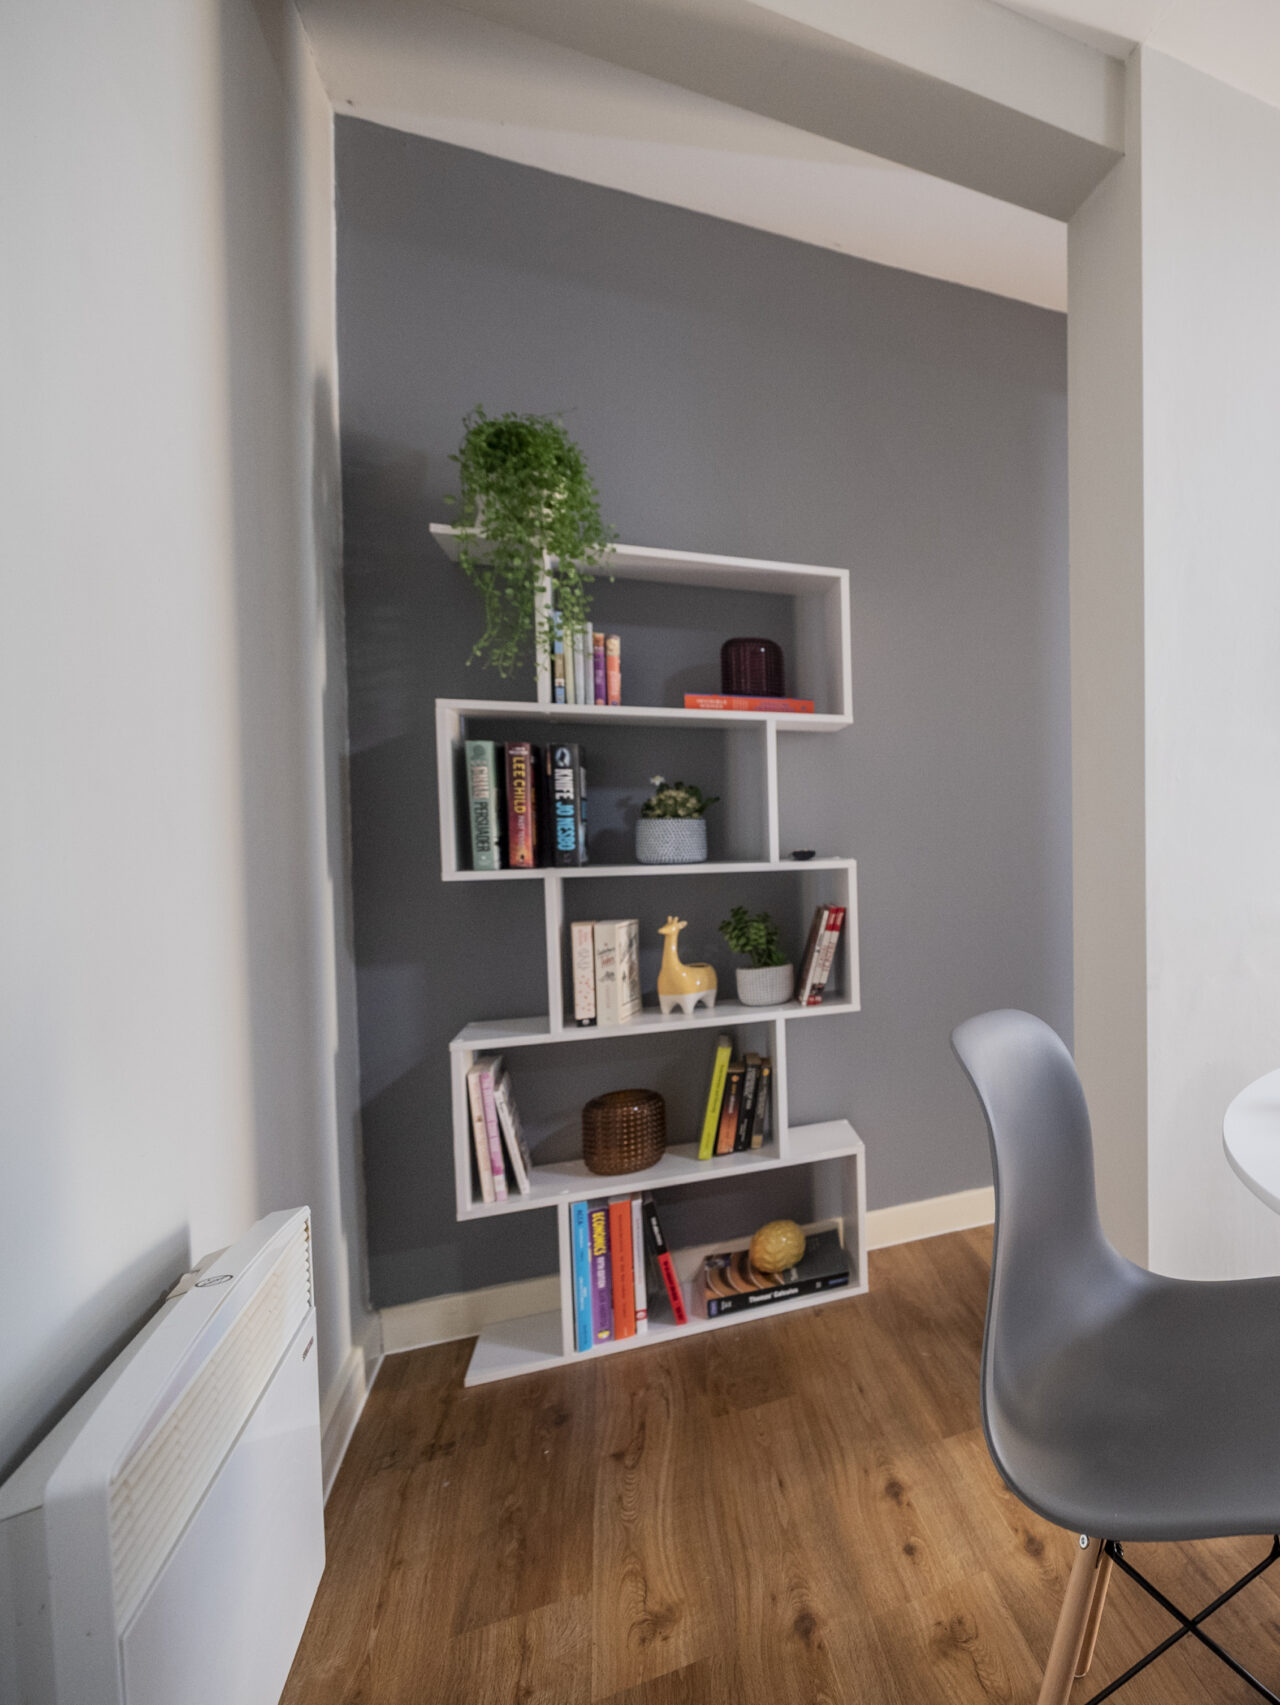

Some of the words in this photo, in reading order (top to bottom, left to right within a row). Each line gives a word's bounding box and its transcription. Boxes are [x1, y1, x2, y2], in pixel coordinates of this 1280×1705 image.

[513, 756, 526, 777] LEE
[513, 779, 526, 814] CHILD
[555, 769, 574, 800] KNIFE
[556, 801, 574, 816] JO
[473, 801, 490, 852] PERSUADER
[592, 1212, 607, 1255] ECONOMICS
[597, 1270, 606, 1288] EDITION
